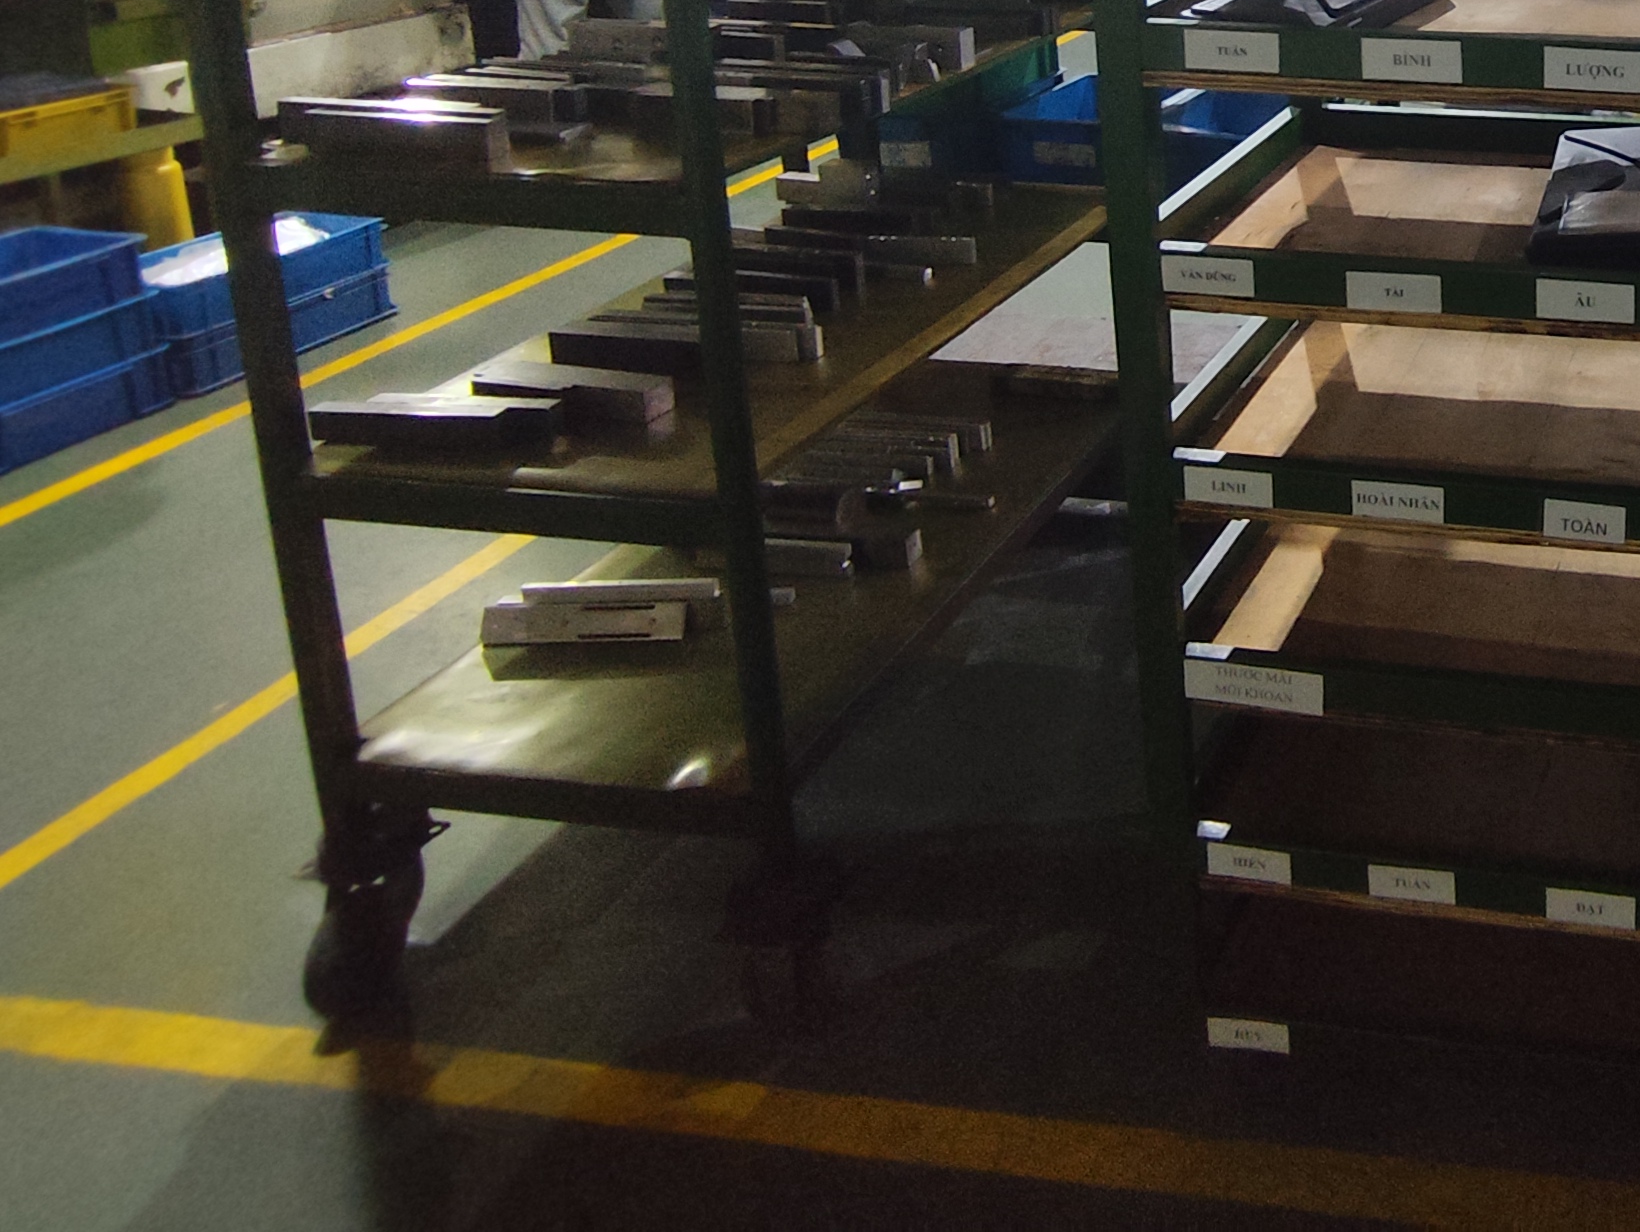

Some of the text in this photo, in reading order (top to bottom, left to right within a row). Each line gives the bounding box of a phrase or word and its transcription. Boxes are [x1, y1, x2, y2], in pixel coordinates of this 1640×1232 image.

[1566, 62, 1625, 80] LƯỢNG
[1212, 480, 1247, 494] LINH
[1560, 517, 1608, 536] TOÀN
[1245, 687, 1293, 703] KHOAN
